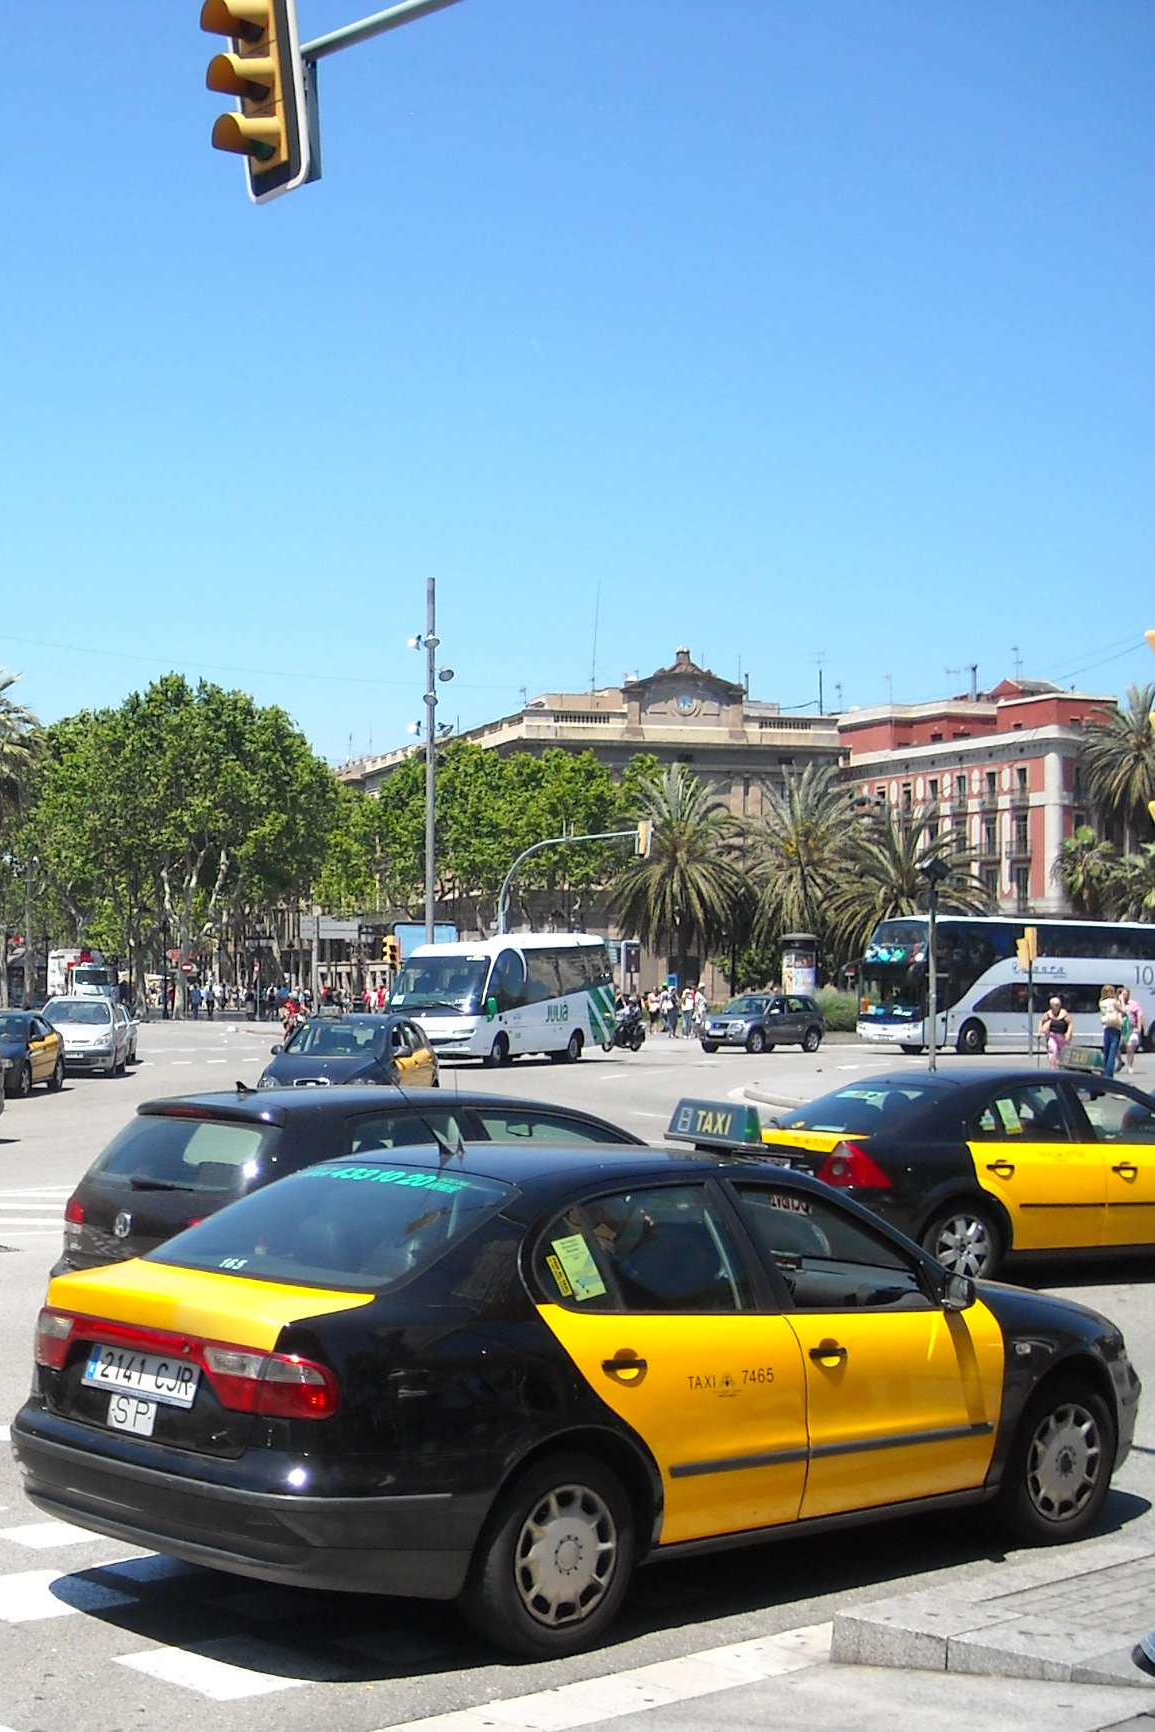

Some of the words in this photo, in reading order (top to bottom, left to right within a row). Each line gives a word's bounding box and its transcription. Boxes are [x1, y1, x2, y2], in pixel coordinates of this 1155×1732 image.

[696, 1110, 733, 1136] TAXI
[100, 1351, 146, 1386] 2141
[154, 1362, 193, 1396] CJR
[687, 1375, 716, 1390] TAXI
[741, 1367, 774, 1385] 7465
[113, 1395, 149, 1428] SP
